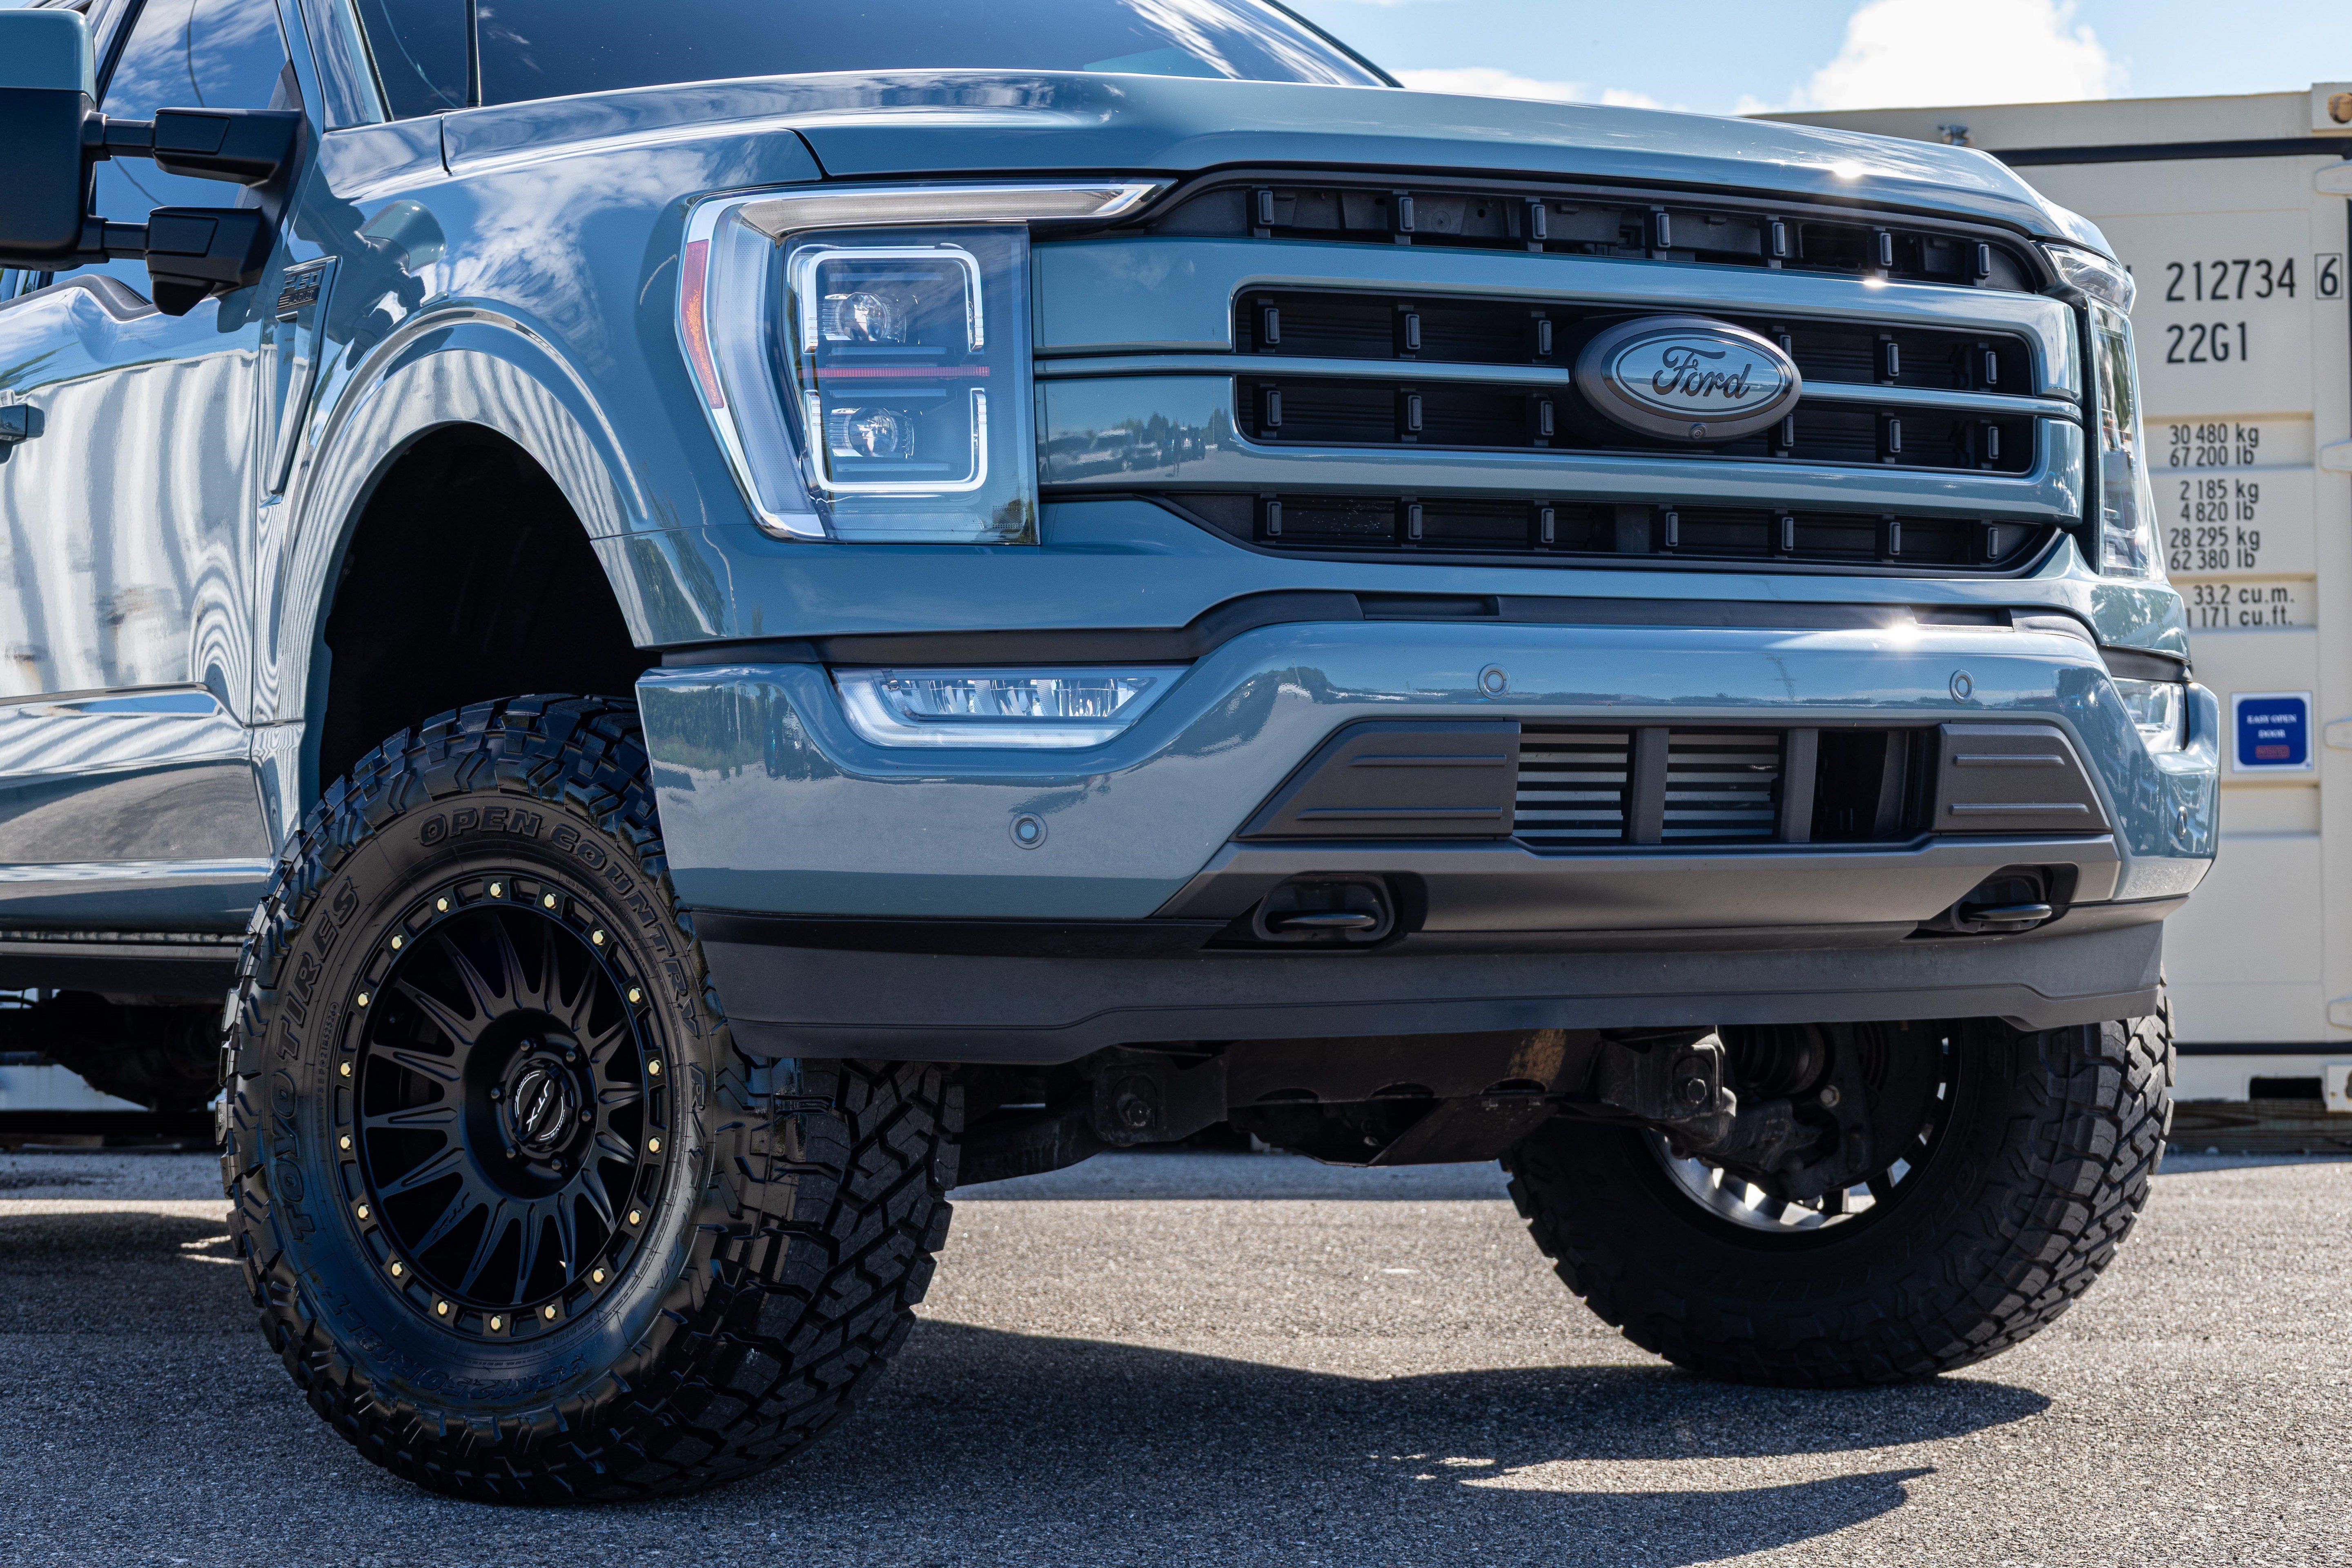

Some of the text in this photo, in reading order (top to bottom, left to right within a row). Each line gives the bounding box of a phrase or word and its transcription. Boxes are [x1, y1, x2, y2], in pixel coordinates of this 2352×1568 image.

[2166, 257, 2338, 302] 212734 6
[2167, 321, 2247, 364] 22G1
[1652, 346, 1751, 399] Ford
[2169, 423, 2259, 449] 30 480 kg
[2169, 445, 2254, 468] 67 200 lb
[2180, 479, 2259, 503] 2 185 kg
[2180, 500, 2254, 523] 4 820 lb
[2170, 526, 2260, 551] 28 295 kg
[2170, 548, 2254, 571] 62 380 lb
[2194, 584, 2230, 606] 33.2
[2201, 606, 2230, 628] 171
[419, 806, 541, 847] OPEN
[549, 822, 700, 1039] COUNTRY
[272, 878, 360, 1243] TOYO TIRES
[526, 1080, 550, 1132] JTX
